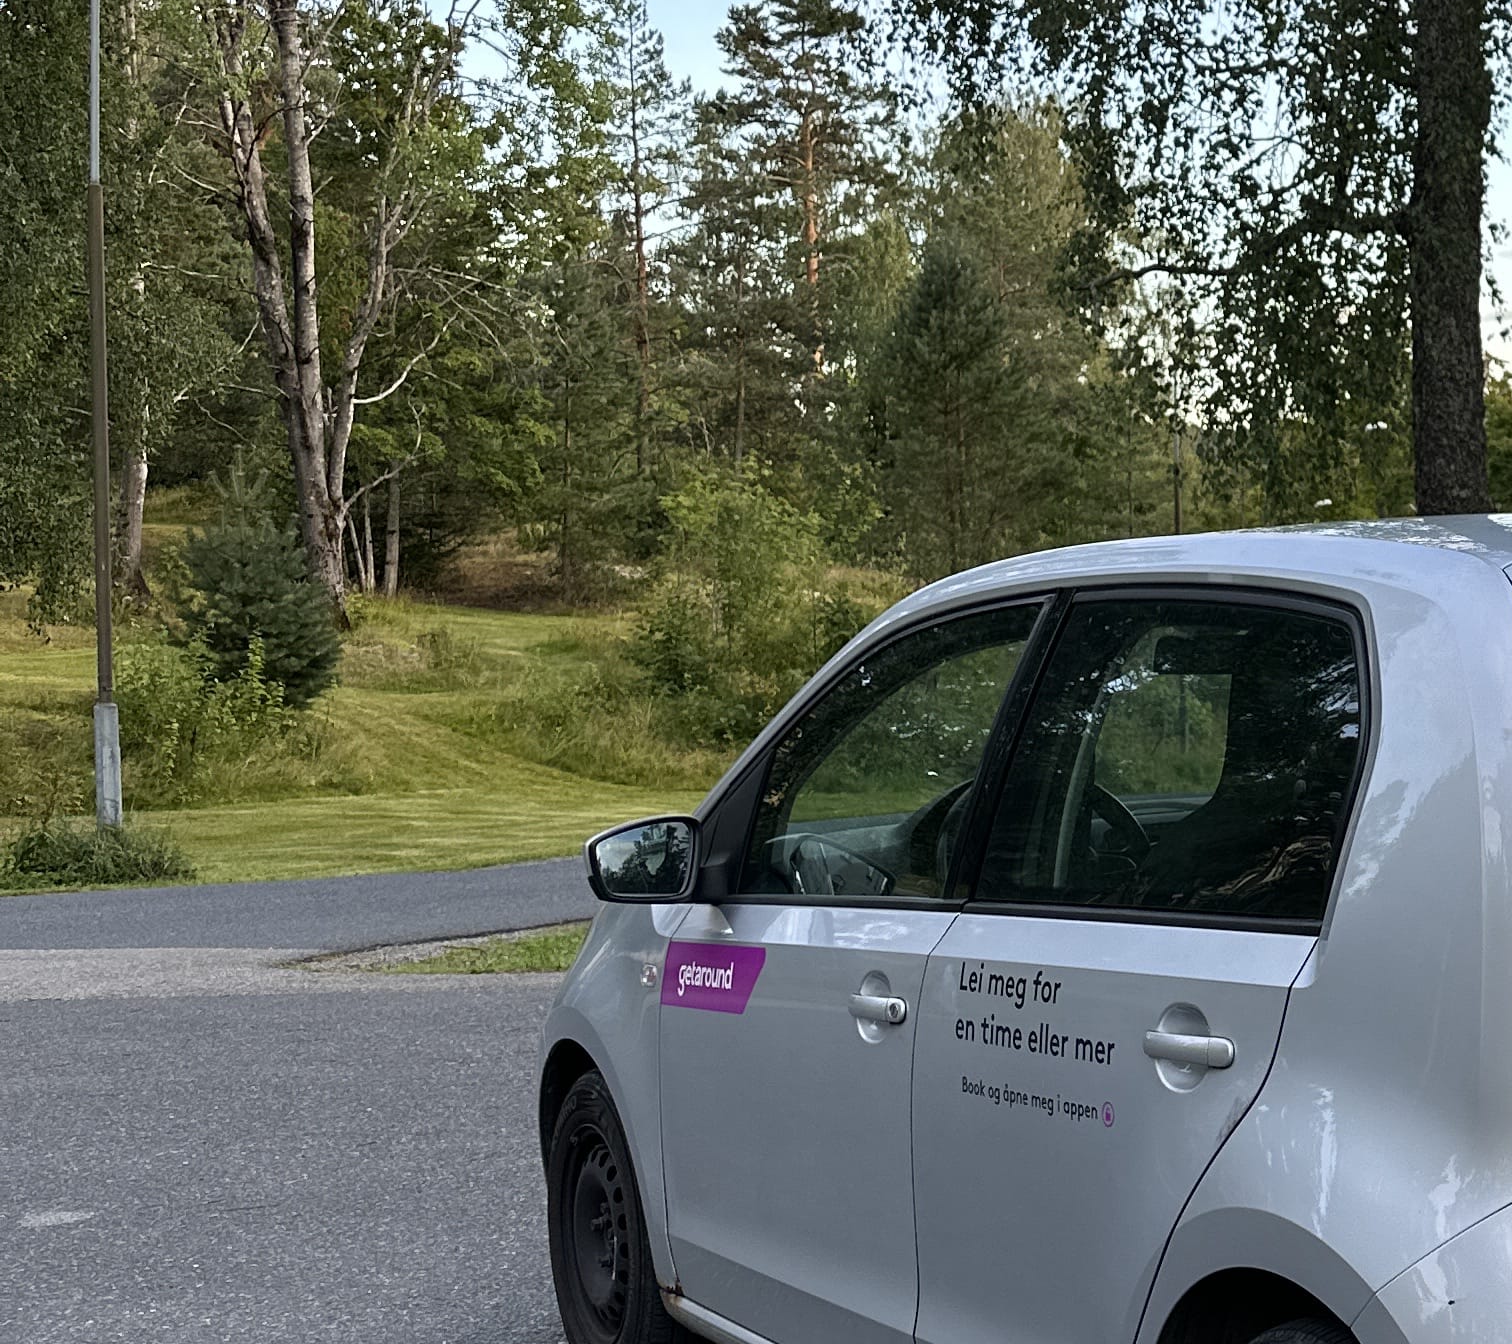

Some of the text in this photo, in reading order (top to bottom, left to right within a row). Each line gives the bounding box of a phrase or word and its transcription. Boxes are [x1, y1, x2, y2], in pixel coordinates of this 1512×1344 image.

[677, 961, 734, 997] getaround
[959, 961, 1062, 1009] Lei meg for
[955, 1013, 1116, 1065] en time eller mer
[961, 1075, 1098, 1122] Book og åpne meg i appen
